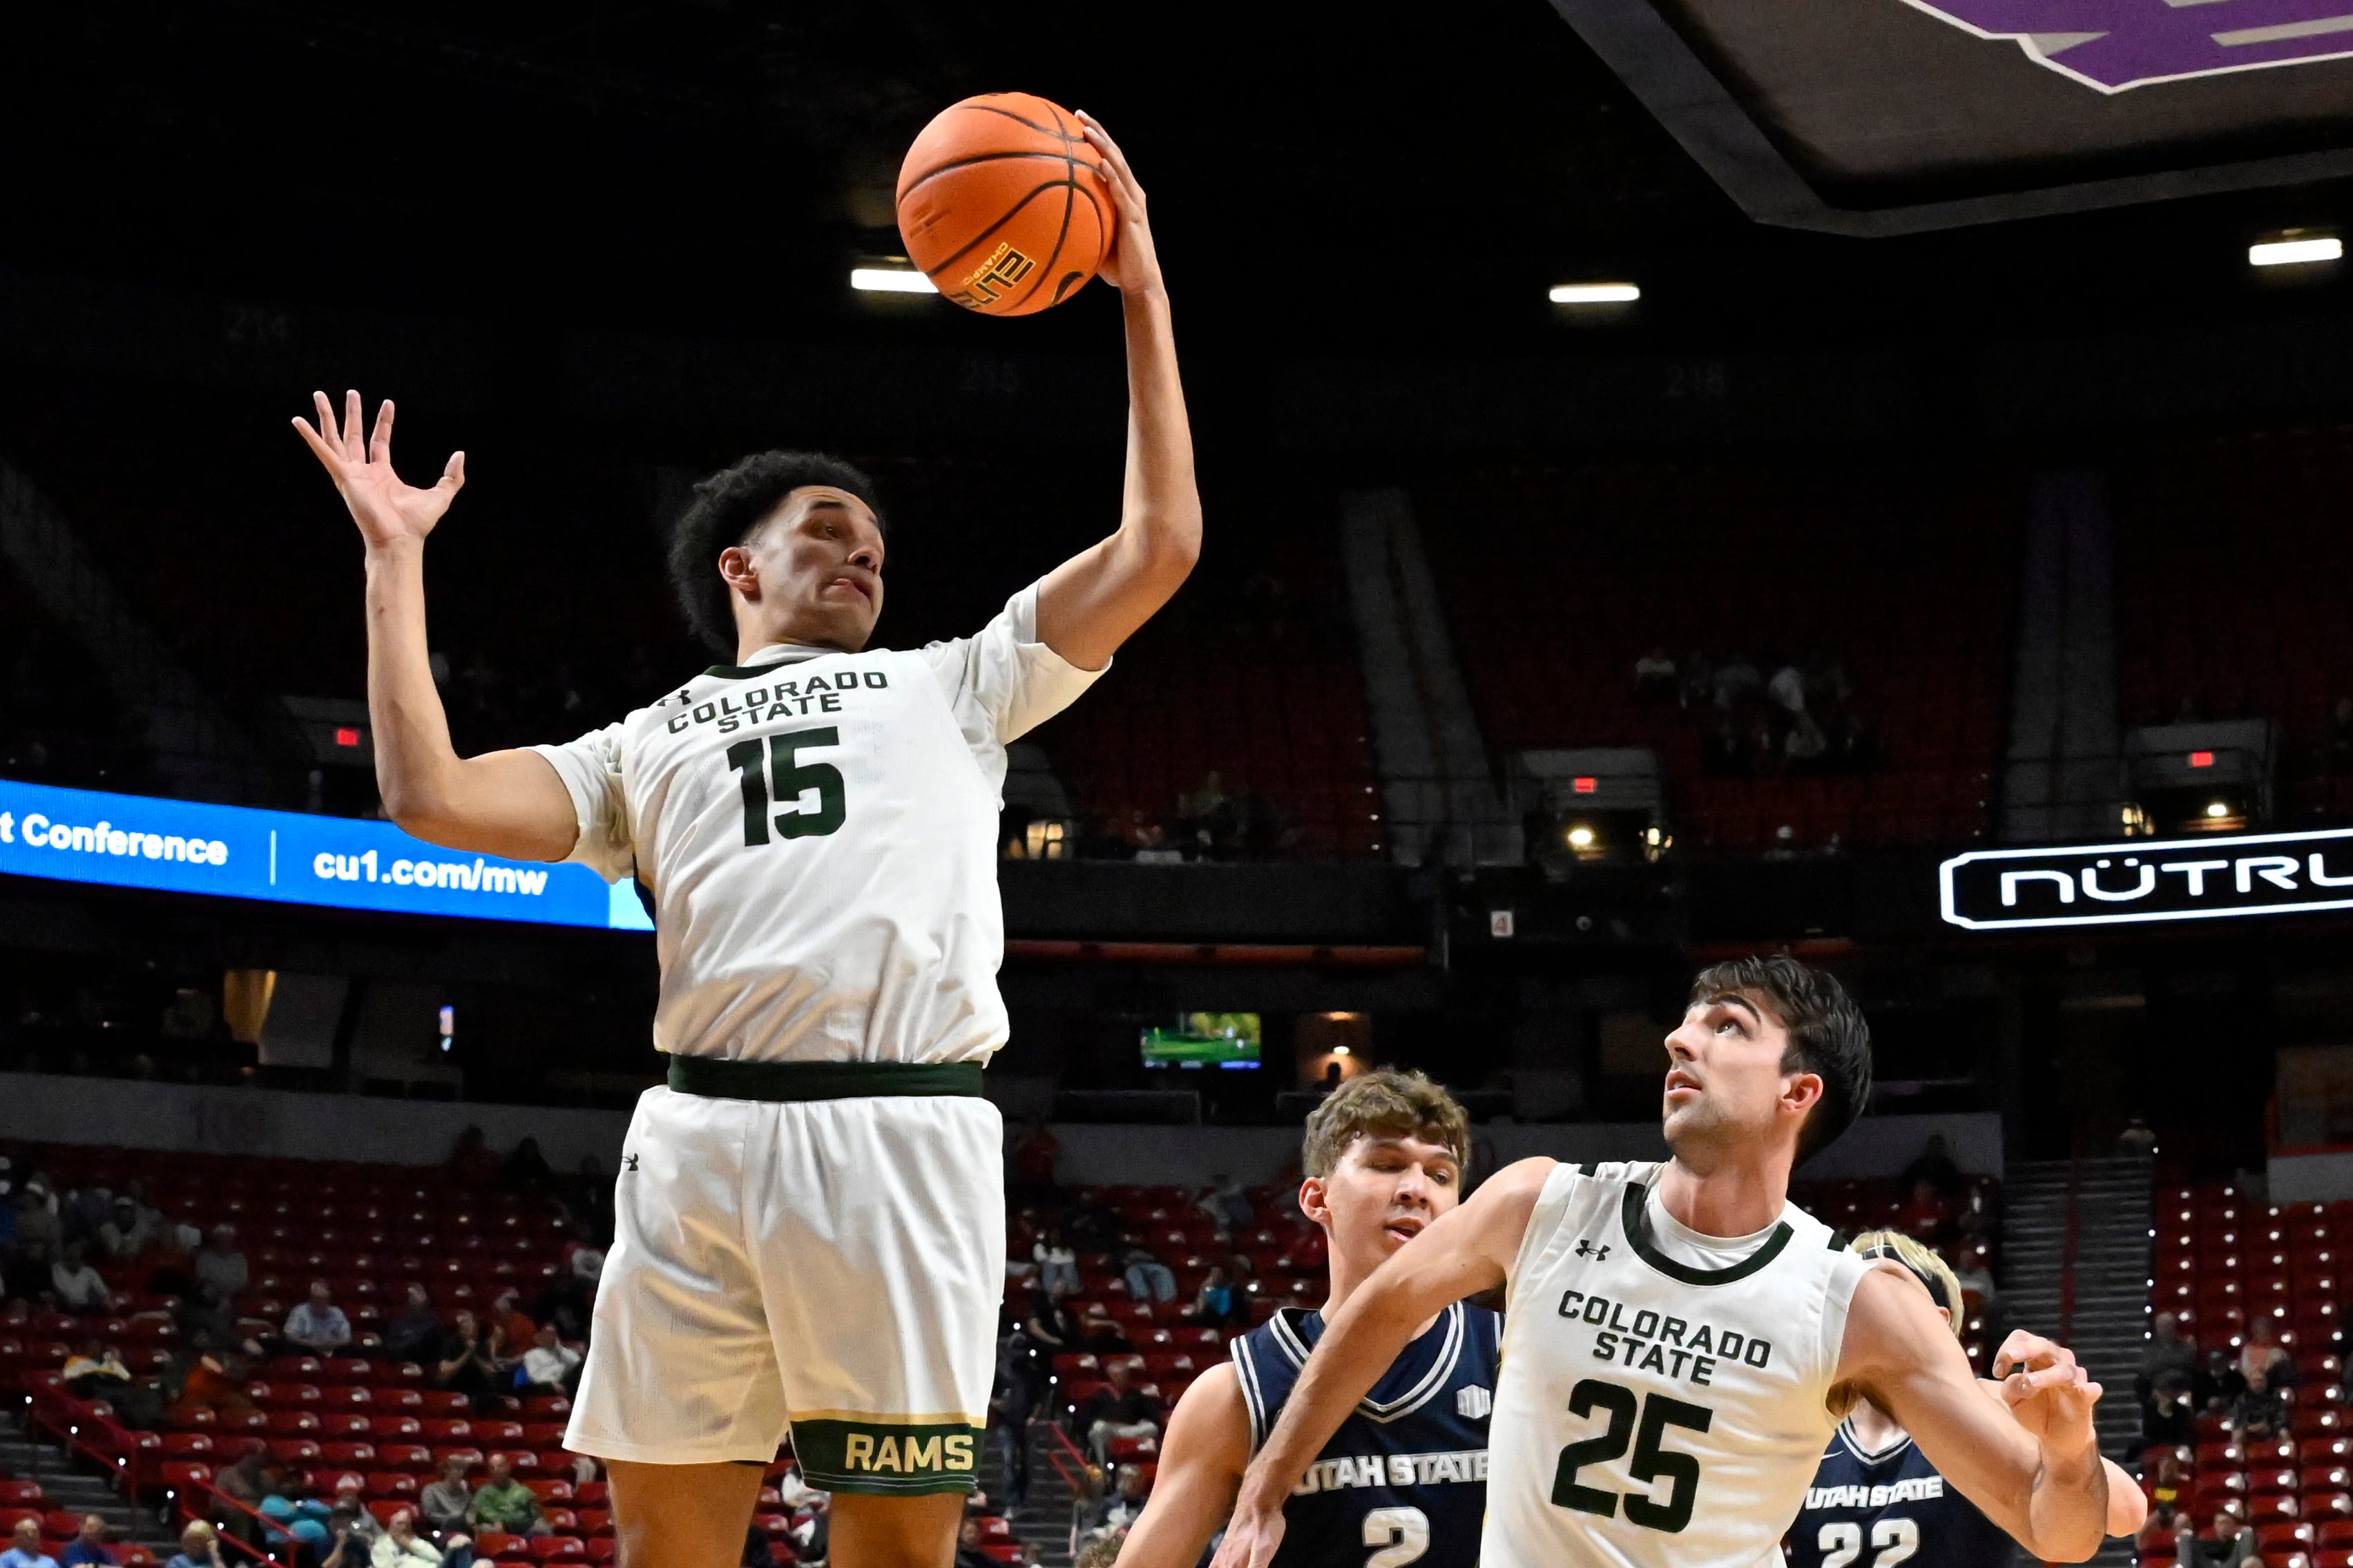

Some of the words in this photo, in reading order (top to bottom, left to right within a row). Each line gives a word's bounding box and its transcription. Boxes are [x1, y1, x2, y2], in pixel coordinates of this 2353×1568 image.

[667, 671, 888, 735] COLORADO
[717, 693, 843, 734] STATE
[726, 726, 847, 847] 15
[21, 813, 229, 867] Conference
[313, 849, 549, 897] cu1.com/mw
[1557, 1290, 1771, 1369] COLORADO
[1593, 1331, 1717, 1386] STATE
[845, 1433, 974, 1473] RAMS
[1291, 1455, 1386, 1497] UTAH
[1387, 1449, 1488, 1487] STATE
[1551, 1378, 1714, 1534] 25
[1805, 1484, 1870, 1510] UTAH
[1869, 1475, 1943, 1507] STATE
[1361, 1506, 1430, 1568] 2
[1817, 1517, 1920, 1568] 22
